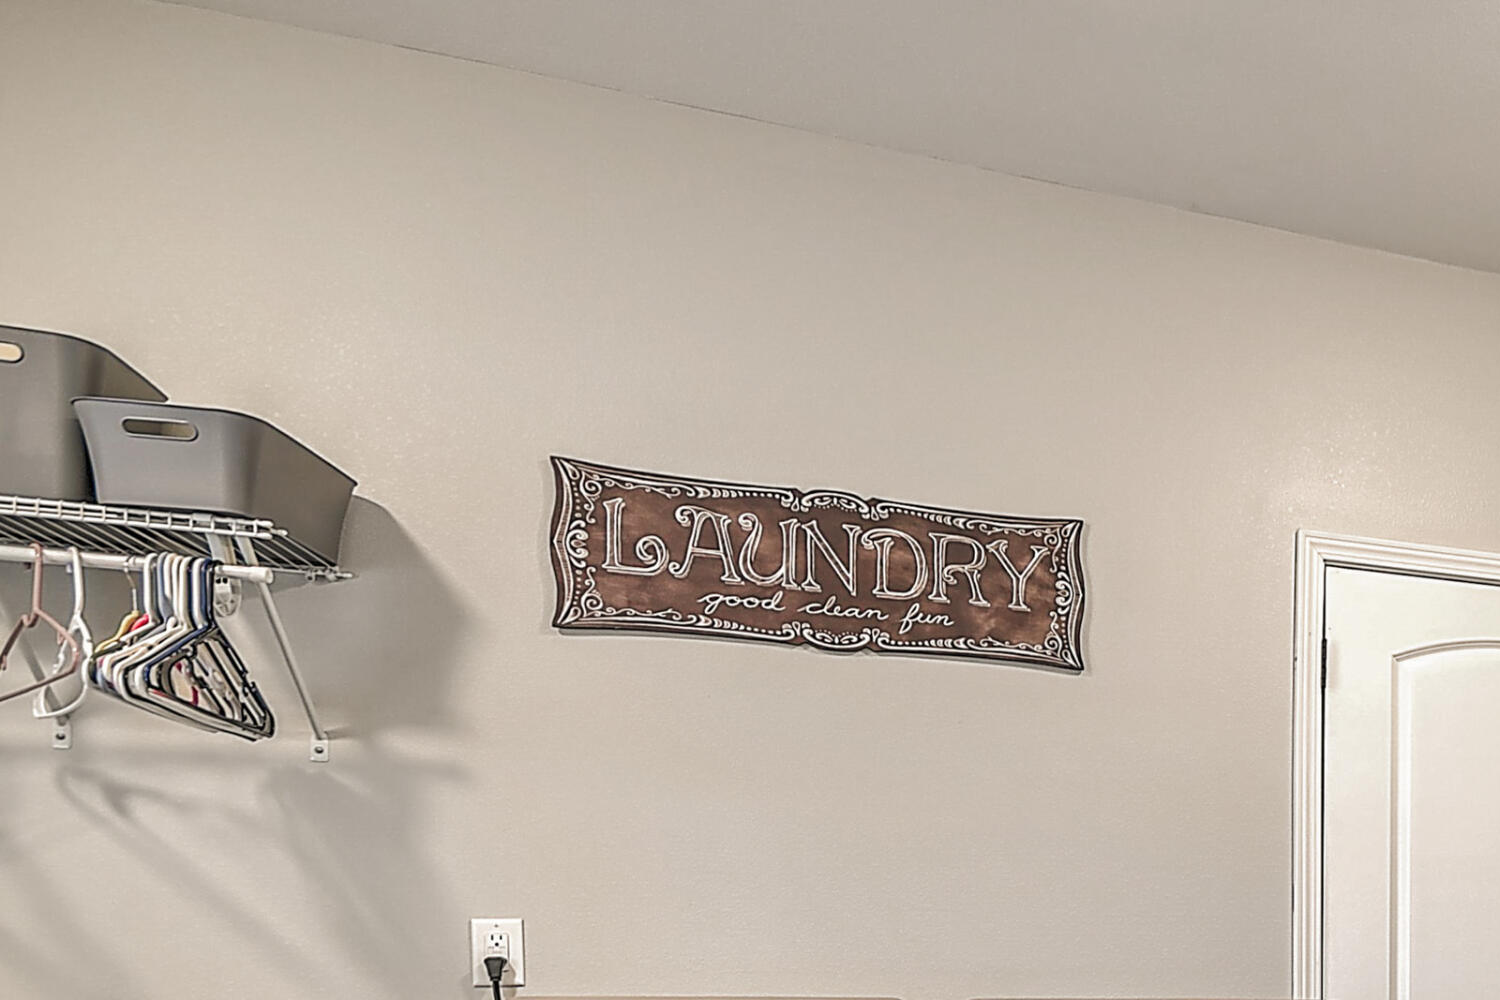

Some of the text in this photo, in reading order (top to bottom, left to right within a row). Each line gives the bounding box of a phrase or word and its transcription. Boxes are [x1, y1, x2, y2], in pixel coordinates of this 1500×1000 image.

[600, 497, 1050, 612] LAUNDRY
[697, 590, 955, 635] good clean fun
